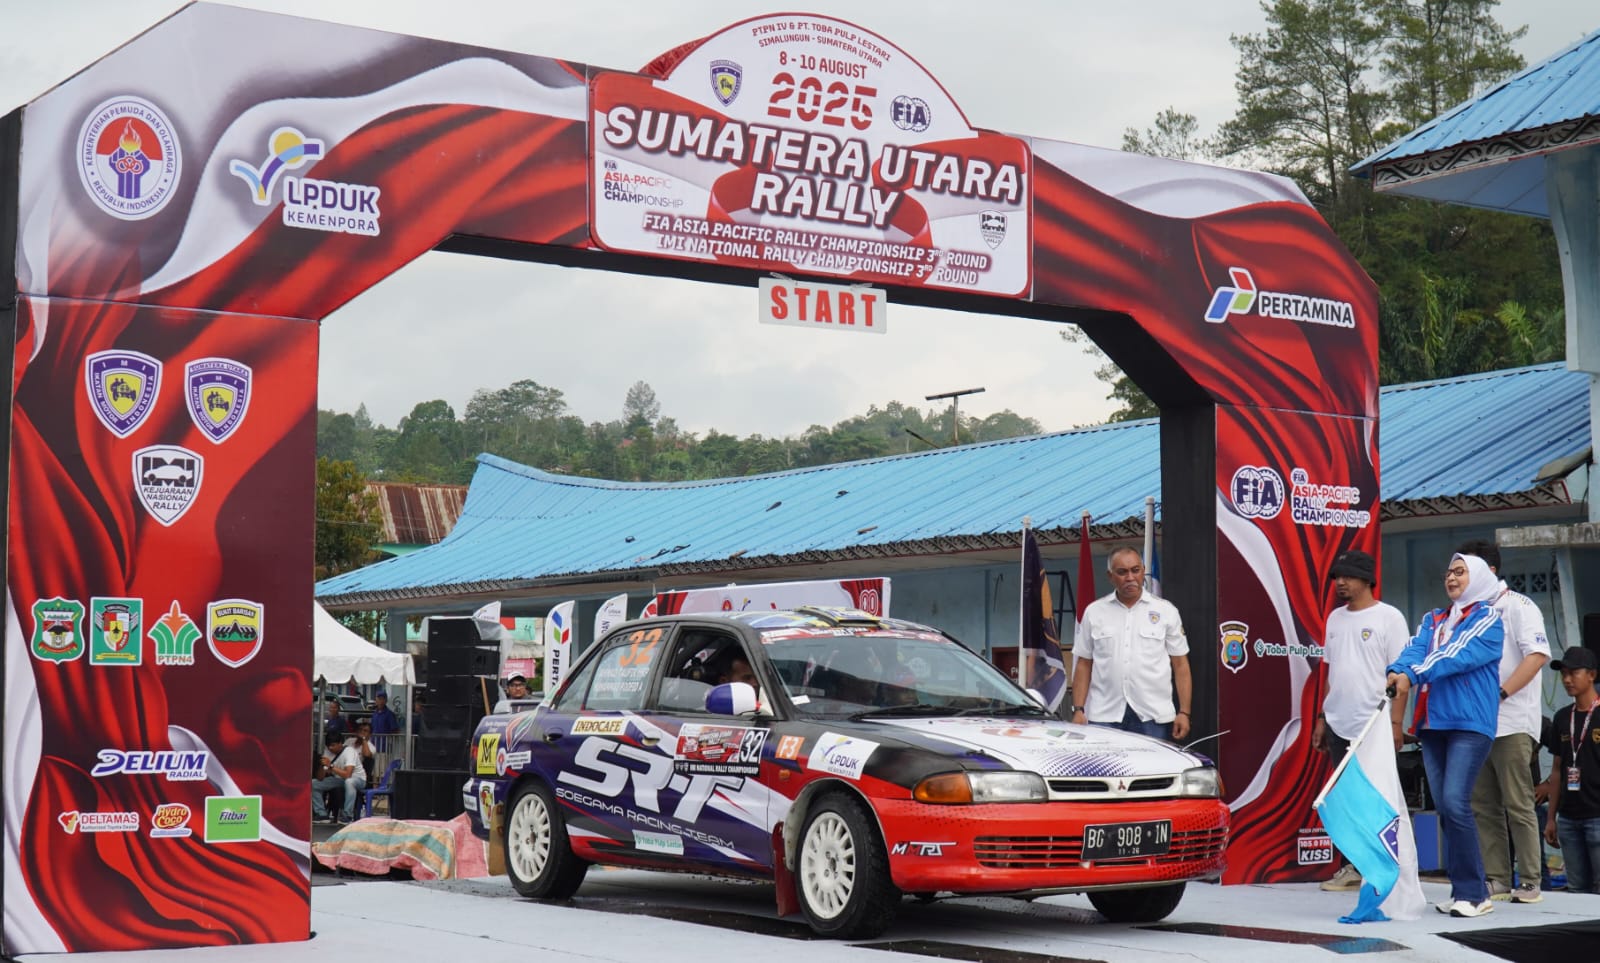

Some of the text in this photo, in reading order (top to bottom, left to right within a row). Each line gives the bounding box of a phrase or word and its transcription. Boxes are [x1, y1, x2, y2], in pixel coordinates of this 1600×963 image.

[752, 24, 775, 36] PTPN
[777, 23, 786, 32] IV
[812, 23, 832, 34] TOBA
[834, 27, 857, 42] PULP
[858, 36, 891, 61] LESTARI
[758, 34, 810, 47] SIMALUNGUN
[817, 36, 857, 54] SUMATERA
[859, 51, 882, 68] UTARA
[780, 51, 787, 66] 8
[800, 55, 816, 70] 10
[820, 60, 868, 79] AUGUST
[768, 72, 877, 130] 2025
[86, 106, 173, 174] KEMENTERIAN PEMUDA DAN OLAHRAGA
[605, 107, 1018, 200] SUMATERA UTARA
[94, 180, 166, 210] REPUBLIK INDONESIA
[604, 181, 638, 193] RALLY
[604, 191, 684, 208] CHAMPIONSHIP
[751, 173, 898, 225] RALLY
[288, 210, 376, 232] KEMENPORA
[643, 214, 670, 230] FIA
[673, 218, 709, 234] ASIA
[712, 223, 772, 242] PACIFIC
[775, 230, 818, 248] RALLY
[820, 236, 924, 260] CHAMPIONSHIP
[946, 254, 988, 268] ROUND
[657, 234, 684, 250] IMI
[688, 239, 760, 260] NATIONAL
[763, 246, 808, 263] RALLY
[810, 251, 914, 276] CHAMPIONSHIP
[937, 269, 978, 284] ROUND
[770, 286, 878, 326] START
[1262, 296, 1352, 324] PERTAMINA
[100, 401, 118, 424] MOTOR
[126, 374, 154, 425] INDONESIA
[220, 388, 244, 432] INDONESIA
[144, 487, 192, 496] KEJUARAAN
[146, 494, 188, 502] NASIONAL
[1293, 486, 1359, 502] ASIA-PACIFIC
[152, 502, 184, 510] RALLY
[1294, 497, 1326, 510] RALLY
[1294, 510, 1369, 526] CHAMPIONSHIP
[619, 628, 662, 667] 32
[1266, 644, 1324, 656] Toba Pulp Les
[158, 655, 192, 664] PTPN4
[741, 730, 764, 763] 32
[779, 738, 798, 758] F3
[94, 752, 206, 774] DELIUM
[830, 754, 859, 770] LPDUK
[82, 814, 137, 824] DELTAMAS
[156, 816, 182, 828] Coco
[158, 807, 187, 818] Hydro
[220, 811, 248, 820] Fitbar
[556, 788, 734, 850] SOEGAMA RACING TEAM
[1117, 826, 1142, 847] 908
[1301, 849, 1330, 861] KISS
